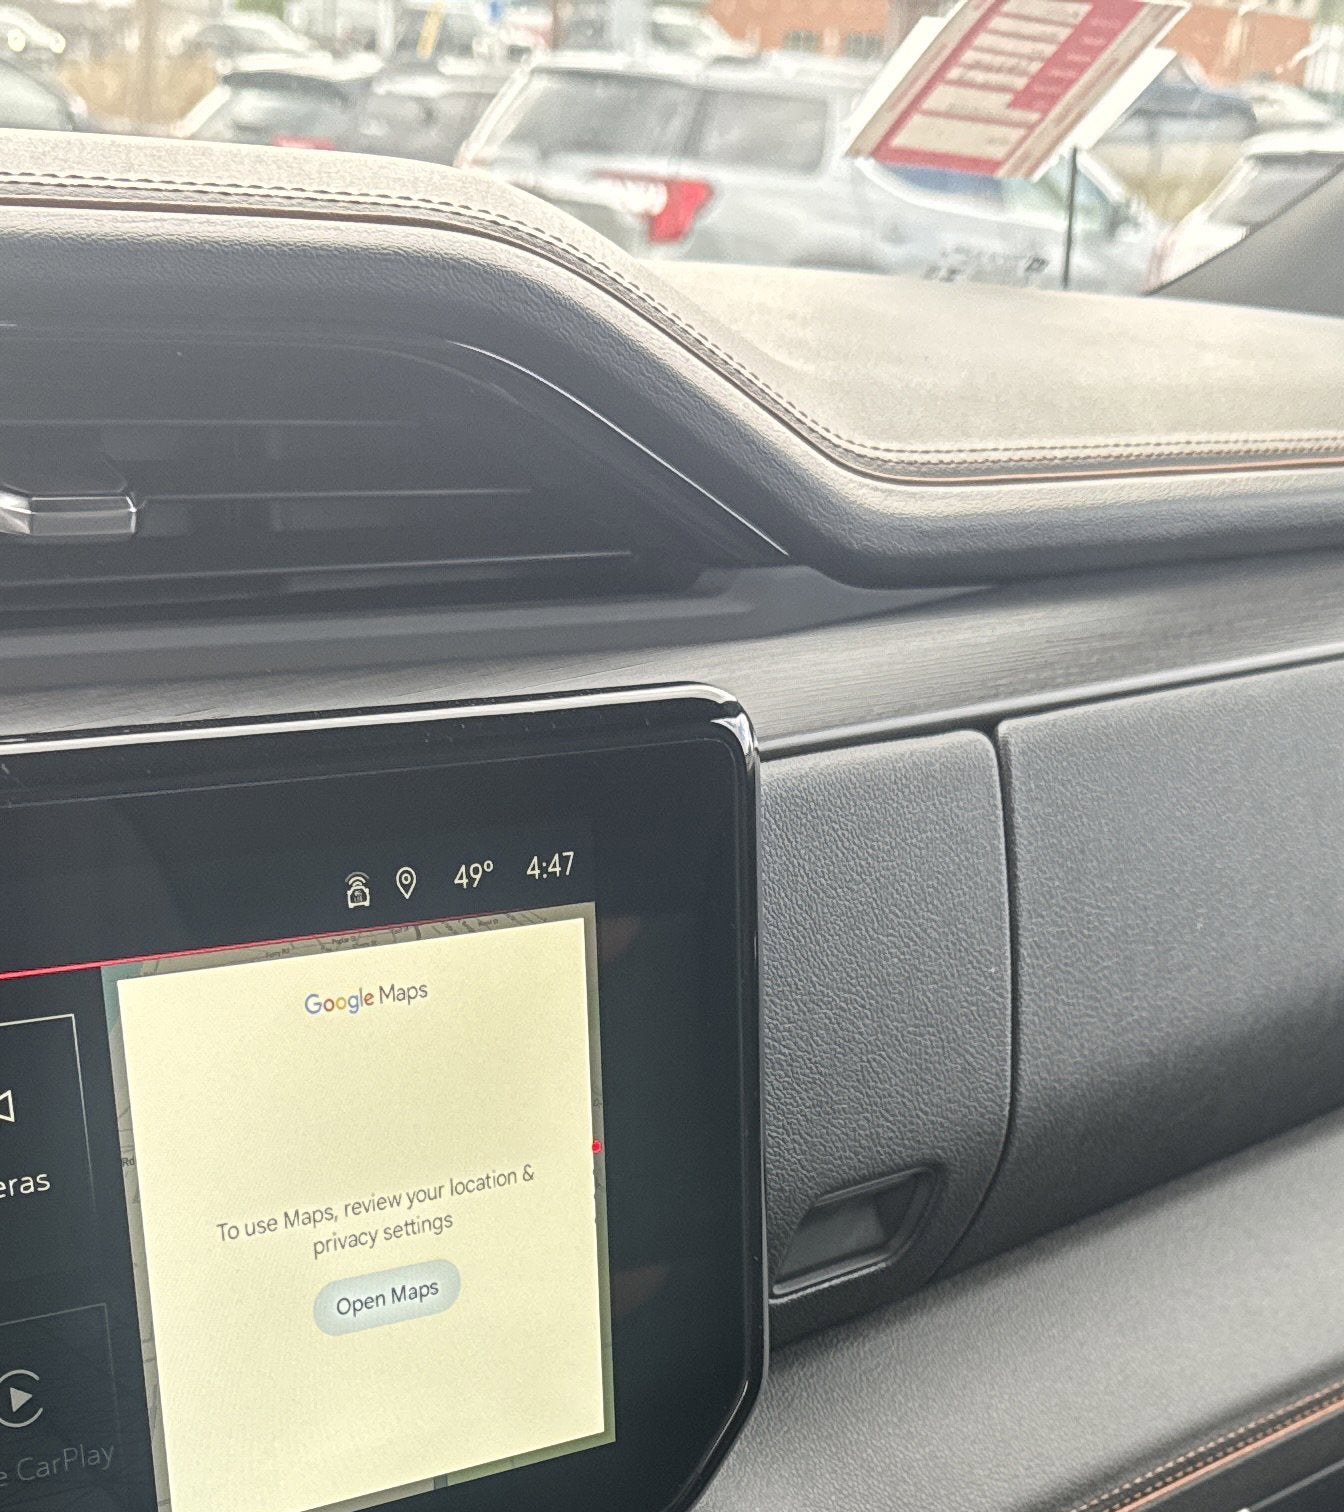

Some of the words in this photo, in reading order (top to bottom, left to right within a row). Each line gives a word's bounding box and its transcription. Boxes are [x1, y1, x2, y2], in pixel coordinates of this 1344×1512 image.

[526, 851, 576, 881] 4:47
[304, 986, 375, 1015] Google
[378, 981, 429, 1006] Maps
[217, 1222, 240, 1243] To
[245, 1214, 278, 1238] use
[283, 1203, 338, 1230] Maps,
[343, 1192, 403, 1219] review
[405, 1182, 445, 1209] your
[449, 1168, 518, 1198] location
[521, 1163, 536, 1183] &
[312, 1228, 379, 1260] privacy
[382, 1212, 454, 1243] settings
[336, 1289, 387, 1318] Open
[391, 1280, 440, 1306] Maps
[16, 1440, 116, 1485] CarPlay
